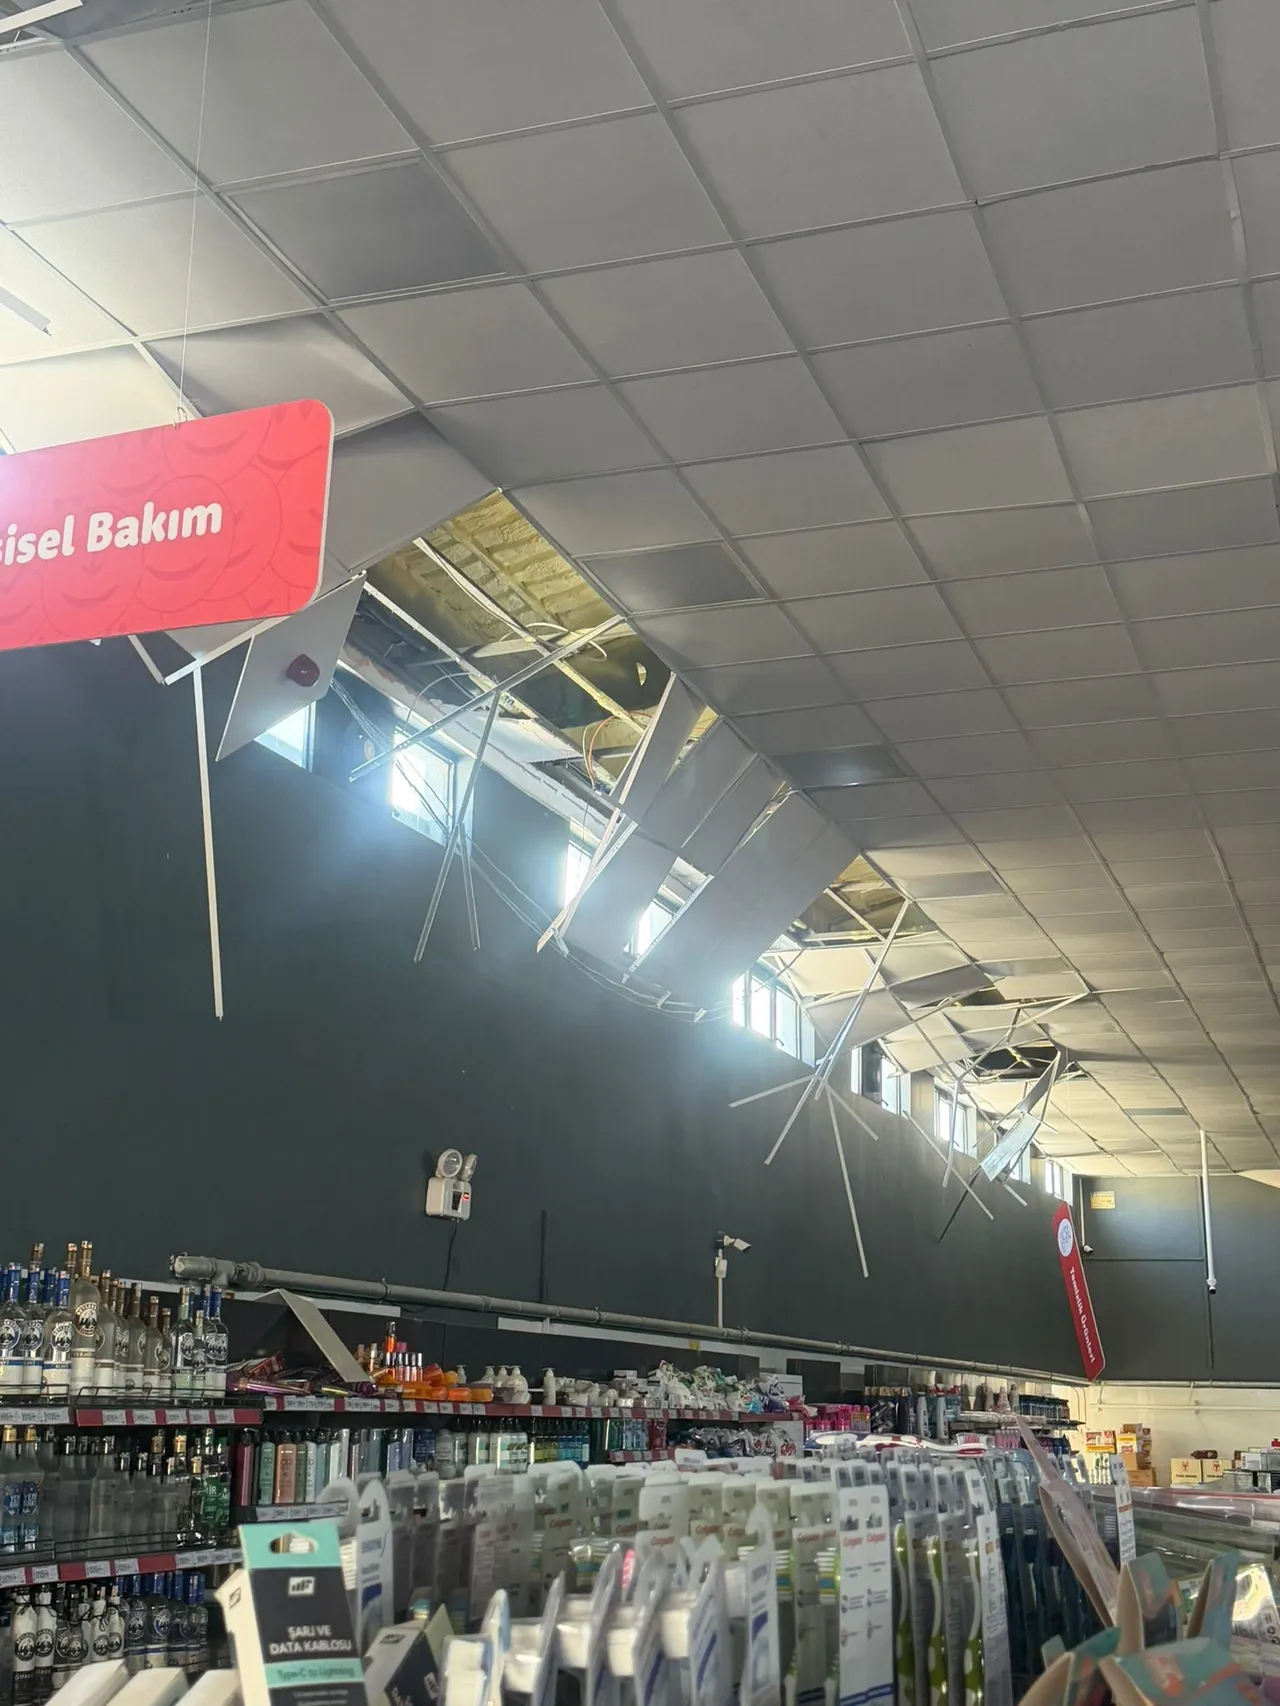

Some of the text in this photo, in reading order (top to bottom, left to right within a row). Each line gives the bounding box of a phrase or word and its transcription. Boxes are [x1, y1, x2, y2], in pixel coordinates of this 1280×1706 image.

[0, 501, 223, 566] isel Bakım
[288, 1625, 332, 1641] ŞARJ VE
[269, 1639, 352, 1655] DATA KABLOSU
